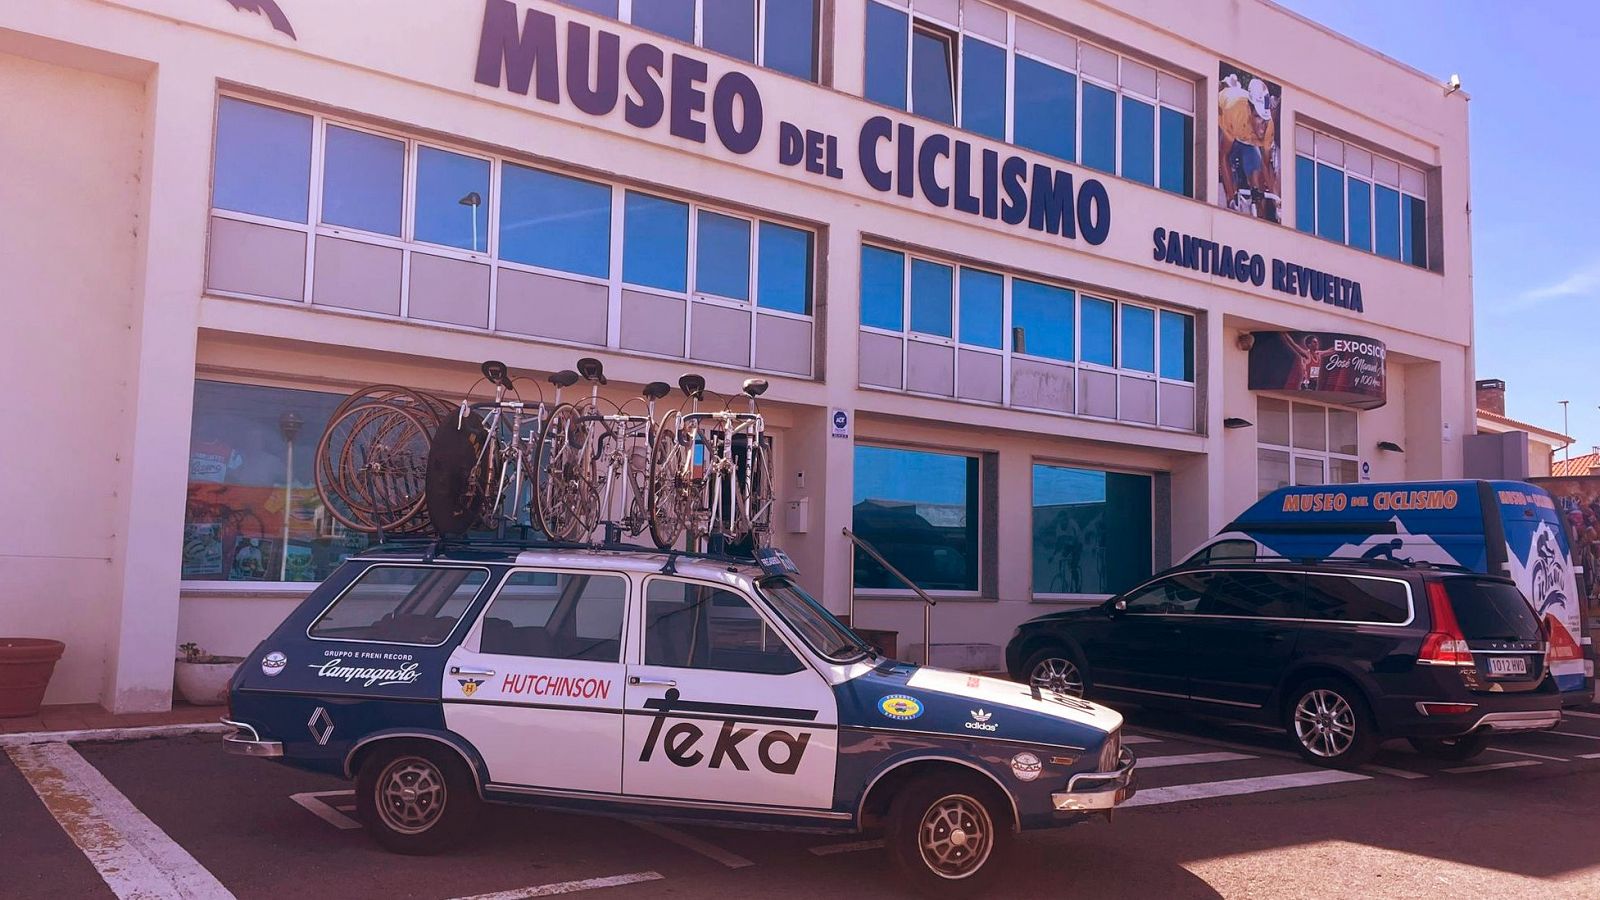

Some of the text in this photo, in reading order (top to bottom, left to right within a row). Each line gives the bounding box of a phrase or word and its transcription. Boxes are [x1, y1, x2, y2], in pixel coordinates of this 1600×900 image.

[474, 1, 1110, 246] MUSEO DEL CICLISMO
[1153, 227, 1363, 313] SANTIAGO REVUELTA
[1326, 354, 1350, 371] José
[1283, 490, 1458, 512] MUSEO DEL CICLISMO
[324, 650, 353, 658] GRUPPO
[383, 653, 413, 661] RECORD
[1492, 659, 1511, 672] 1012
[308, 658, 422, 688] Campagnolo
[502, 673, 611, 700] HUTCHINSON
[965, 721, 996, 732] adidas
